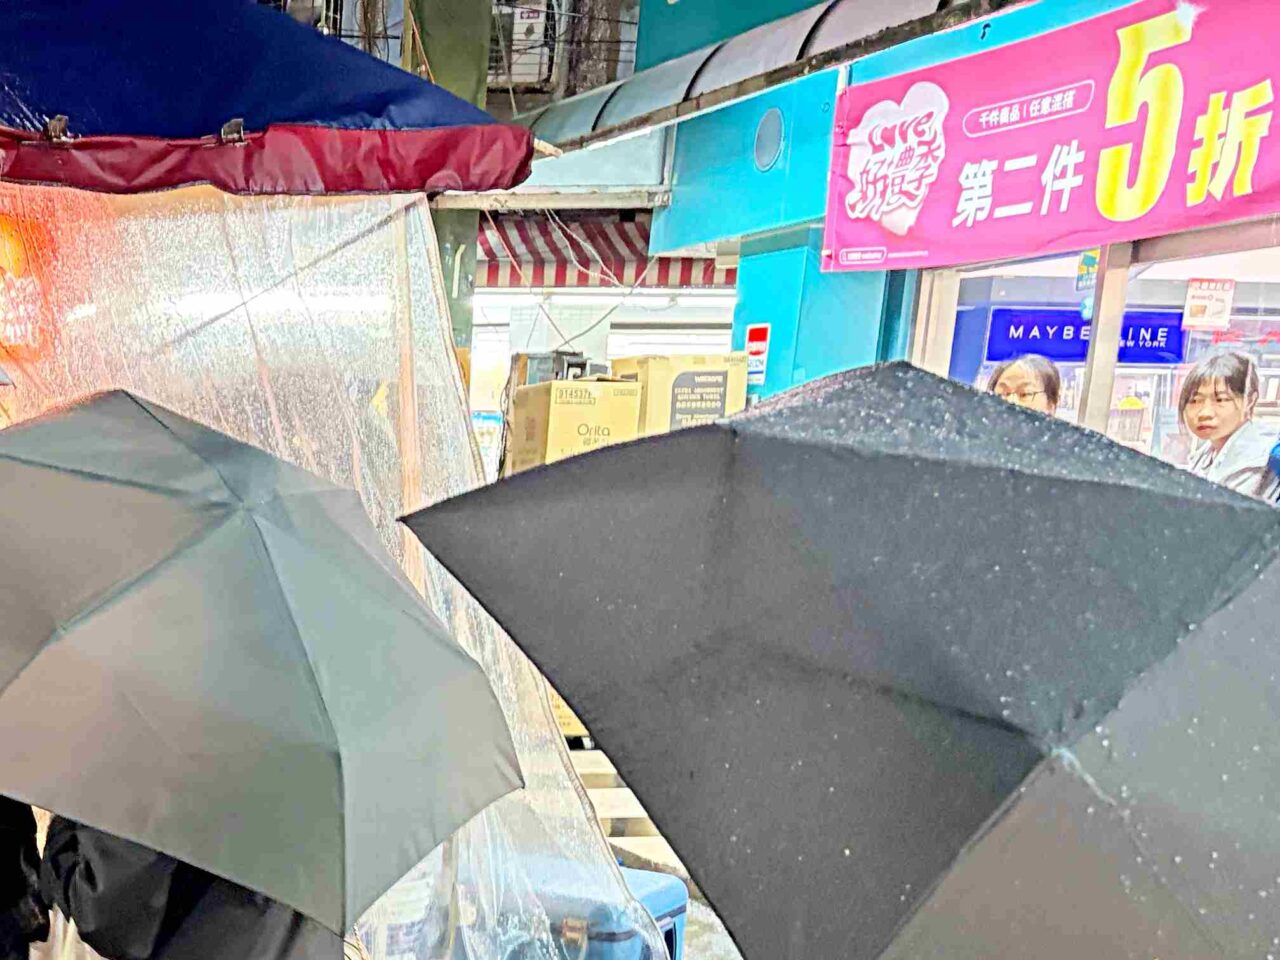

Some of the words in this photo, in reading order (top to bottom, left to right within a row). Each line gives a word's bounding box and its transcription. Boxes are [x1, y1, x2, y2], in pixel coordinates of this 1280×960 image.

[952, 139, 1086, 228] 第二件
[1008, 324, 1169, 341] MAYBEINE
[1138, 340, 1167, 348] YORK
